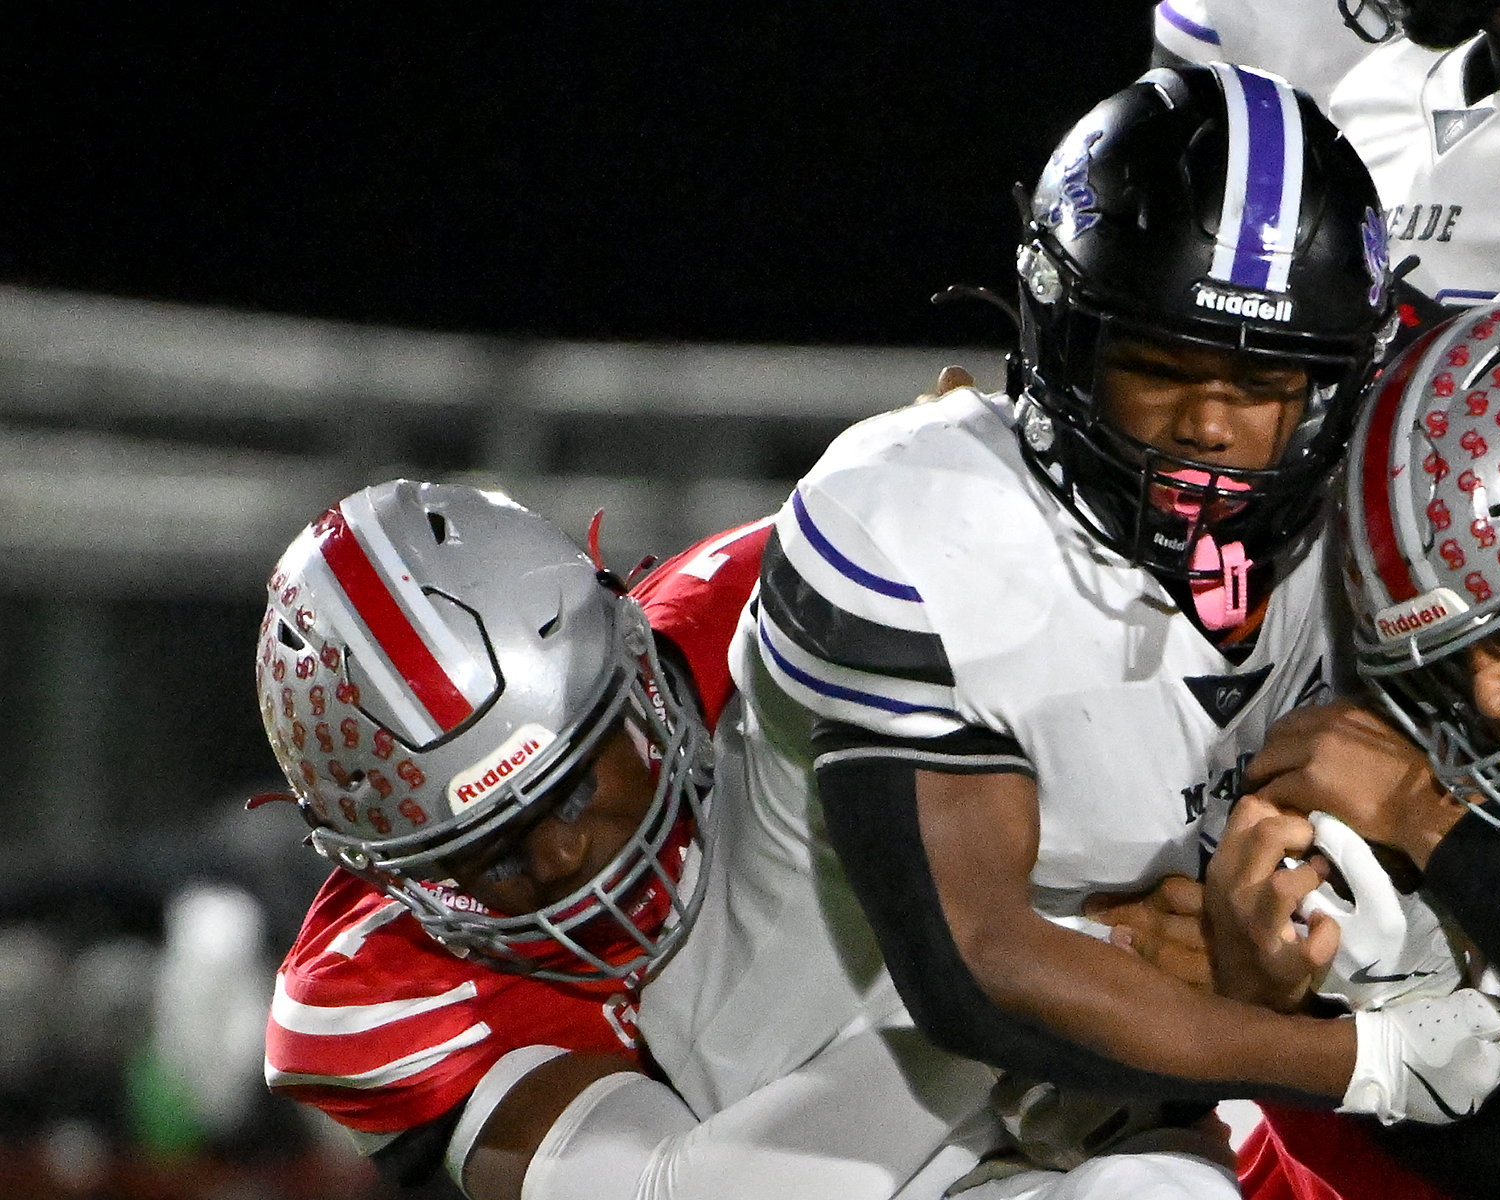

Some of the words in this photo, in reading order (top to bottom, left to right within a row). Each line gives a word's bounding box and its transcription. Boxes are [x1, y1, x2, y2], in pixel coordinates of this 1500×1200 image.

[1385, 204, 1463, 242] EADE
[1196, 289, 1293, 322] Riddell
[1378, 604, 1447, 637] Riddell
[456, 740, 540, 803] Riddell
